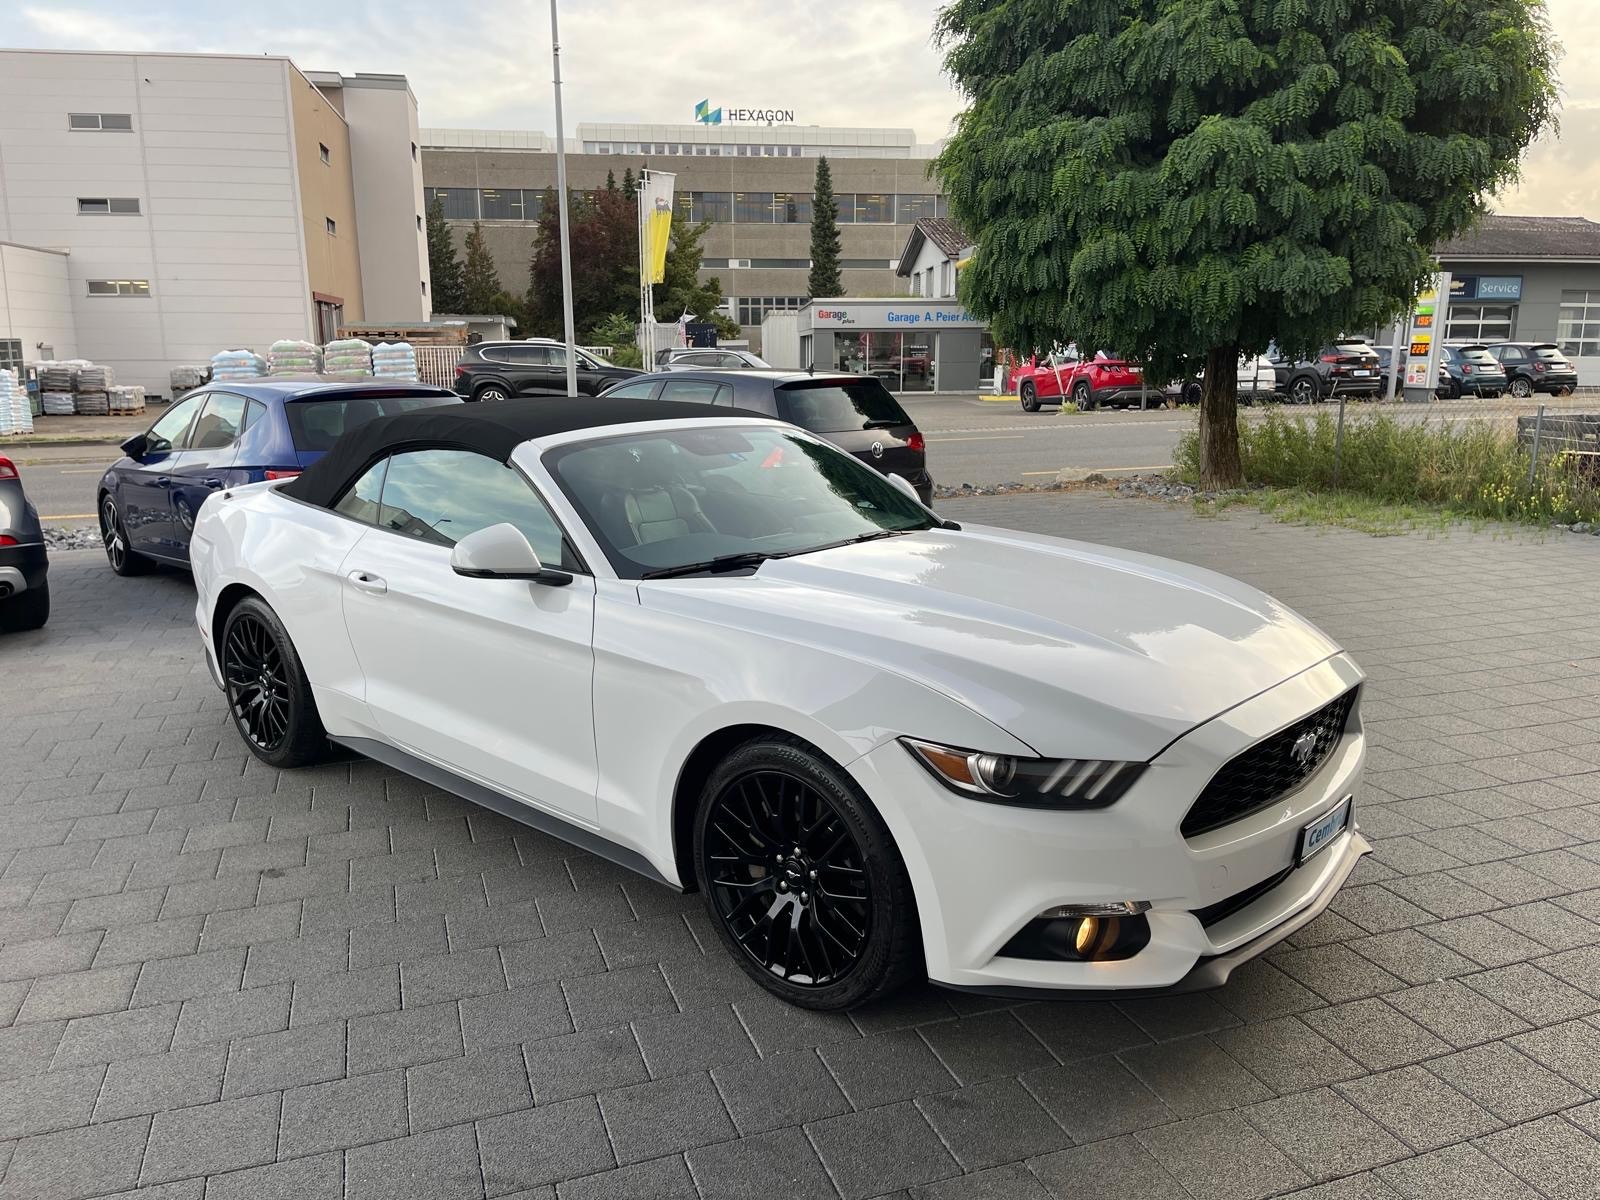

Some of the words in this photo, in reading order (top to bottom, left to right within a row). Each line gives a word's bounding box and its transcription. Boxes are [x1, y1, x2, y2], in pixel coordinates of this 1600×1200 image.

[728, 109, 794, 122] HEXAGON
[1481, 282, 1519, 293] Service
[818, 310, 848, 321] Garage
[887, 312, 920, 324] Garage
[936, 312, 960, 322] Peier
